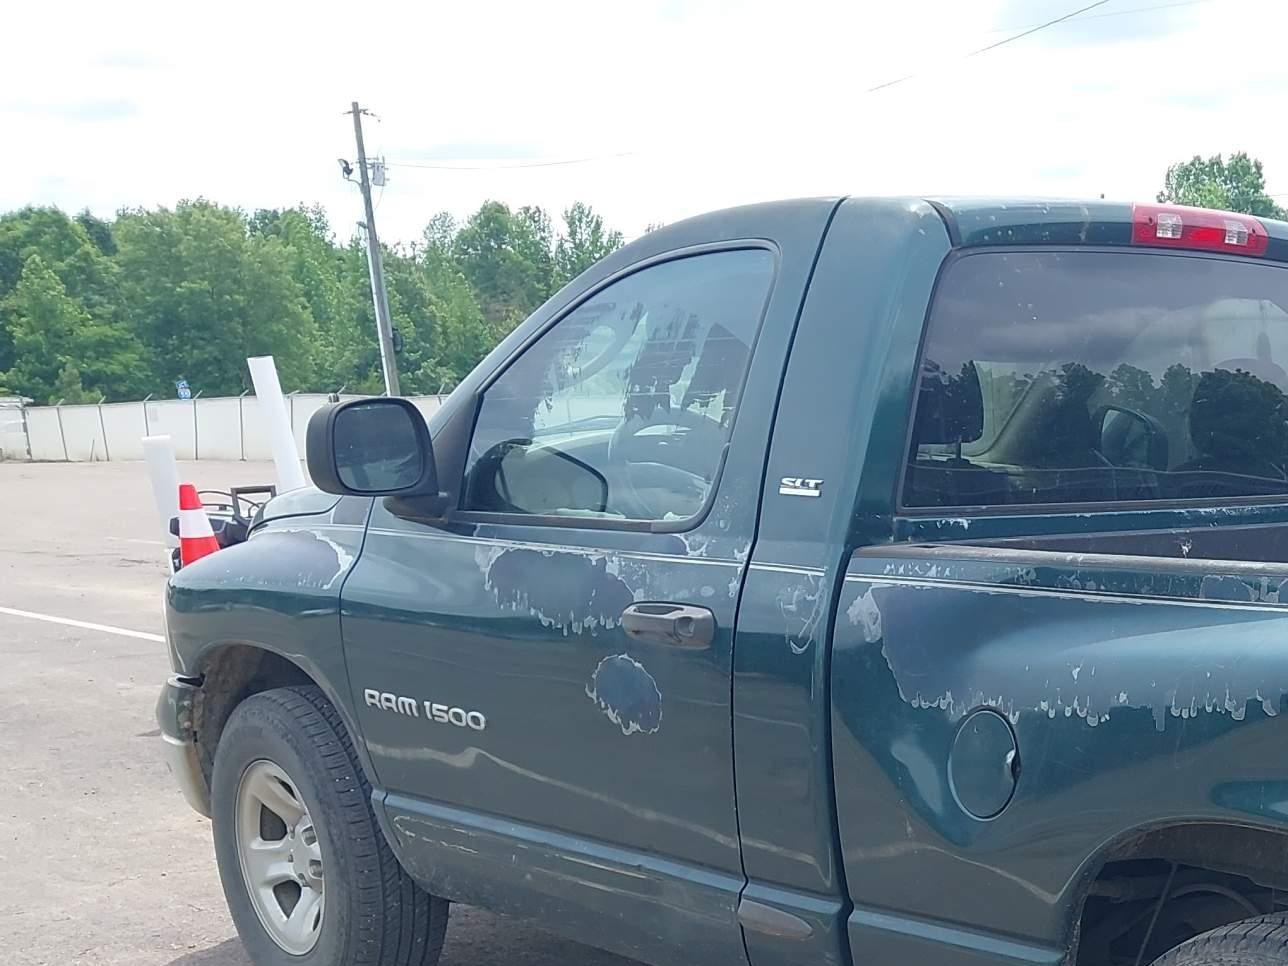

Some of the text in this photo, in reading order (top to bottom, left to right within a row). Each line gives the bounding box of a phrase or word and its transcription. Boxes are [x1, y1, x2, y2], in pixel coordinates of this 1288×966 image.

[780, 477, 824, 488] SLT
[364, 688, 486, 731] RAM 1500
